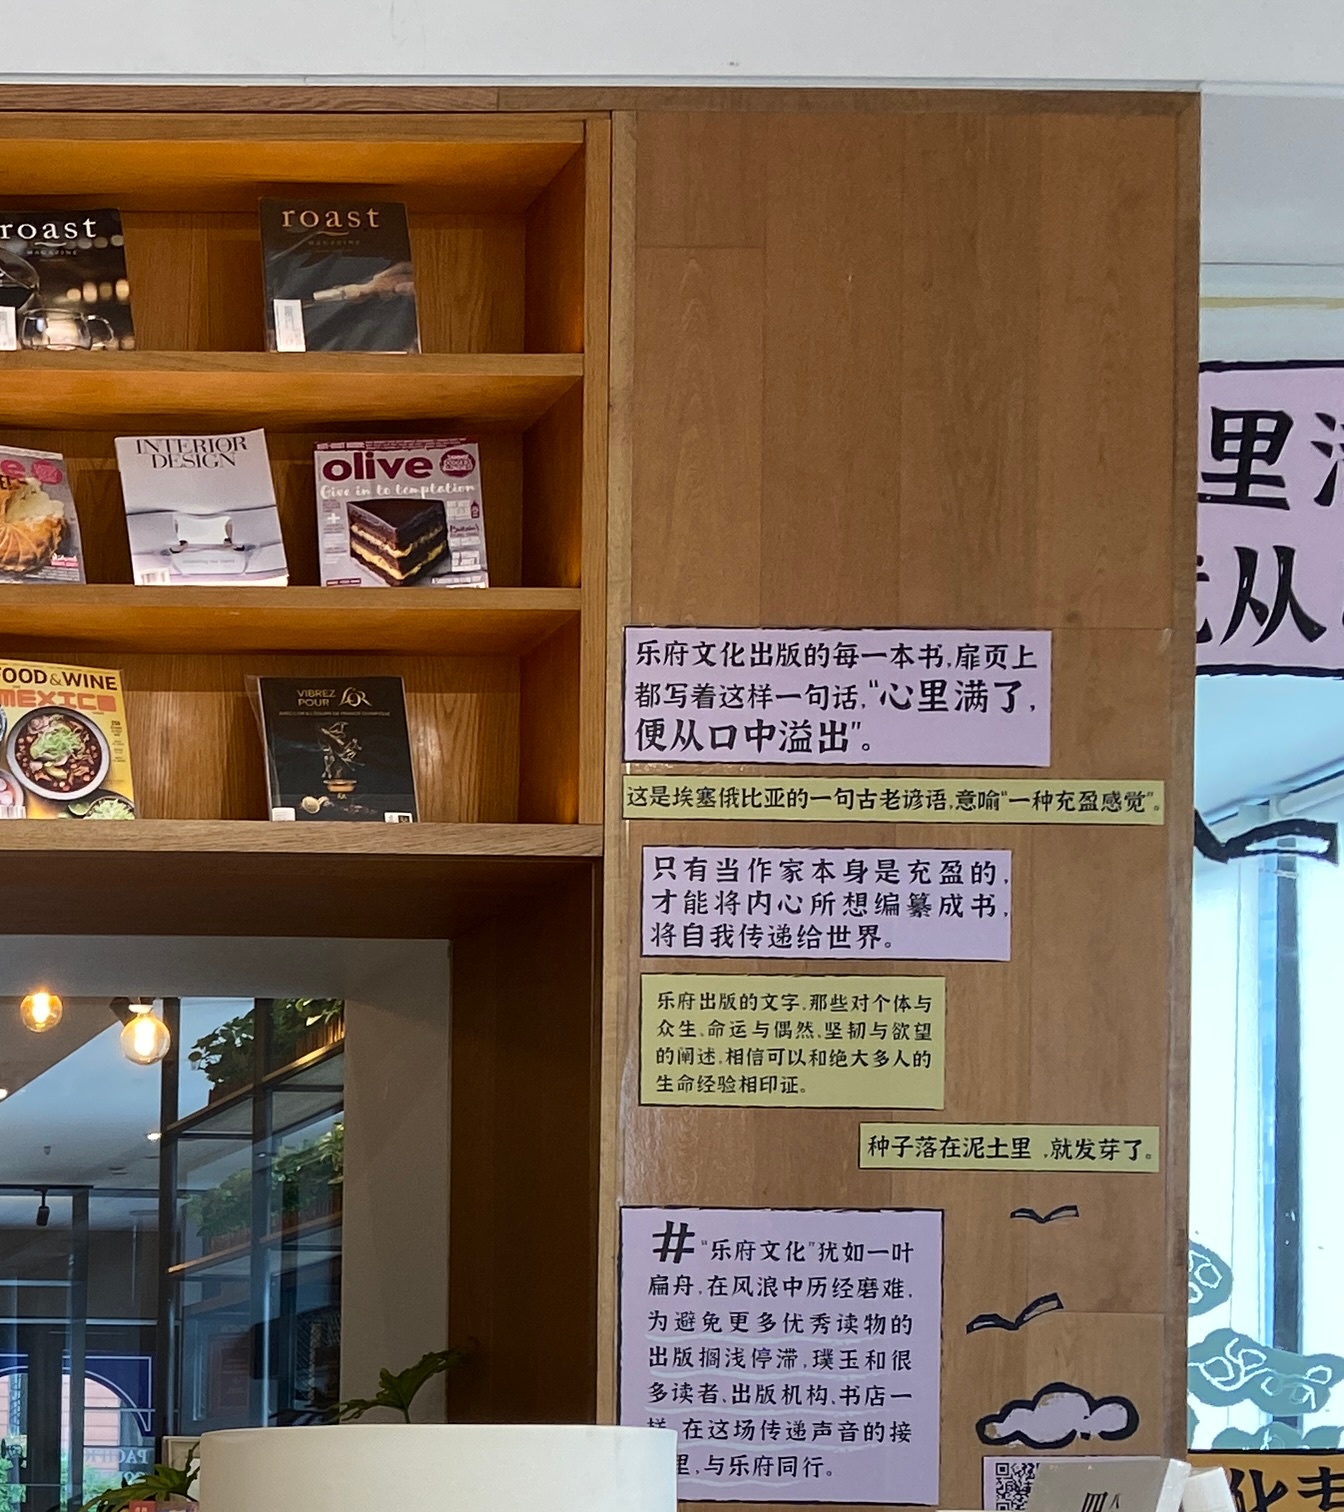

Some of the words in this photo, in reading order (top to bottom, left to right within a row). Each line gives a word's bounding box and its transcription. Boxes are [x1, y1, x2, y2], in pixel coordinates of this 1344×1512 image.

[0, 218, 98, 241] roast
[281, 206, 380, 229] roast
[134, 435, 248, 456] INTERIOR
[152, 452, 237, 470] DESIGN
[322, 451, 434, 482] olive
[634, 639, 1038, 671] 乐府文化出版的每一本书，扉页上
[652, 856, 1010, 887] 只有当作家本身是充盈的，
[650, 889, 1010, 920] 才能将内心所想编纂成书，
[649, 922, 894, 951] 将自我传递给世界。
[656, 990, 933, 1015] 乐府出版的文字，那些对个体与
[654, 1073, 809, 1096] 生命经验相印证。
[647, 1274, 914, 1300] 扁舟，在风浪中历经磨难，
[647, 1309, 914, 1336] 为避免更多优秀读物的
